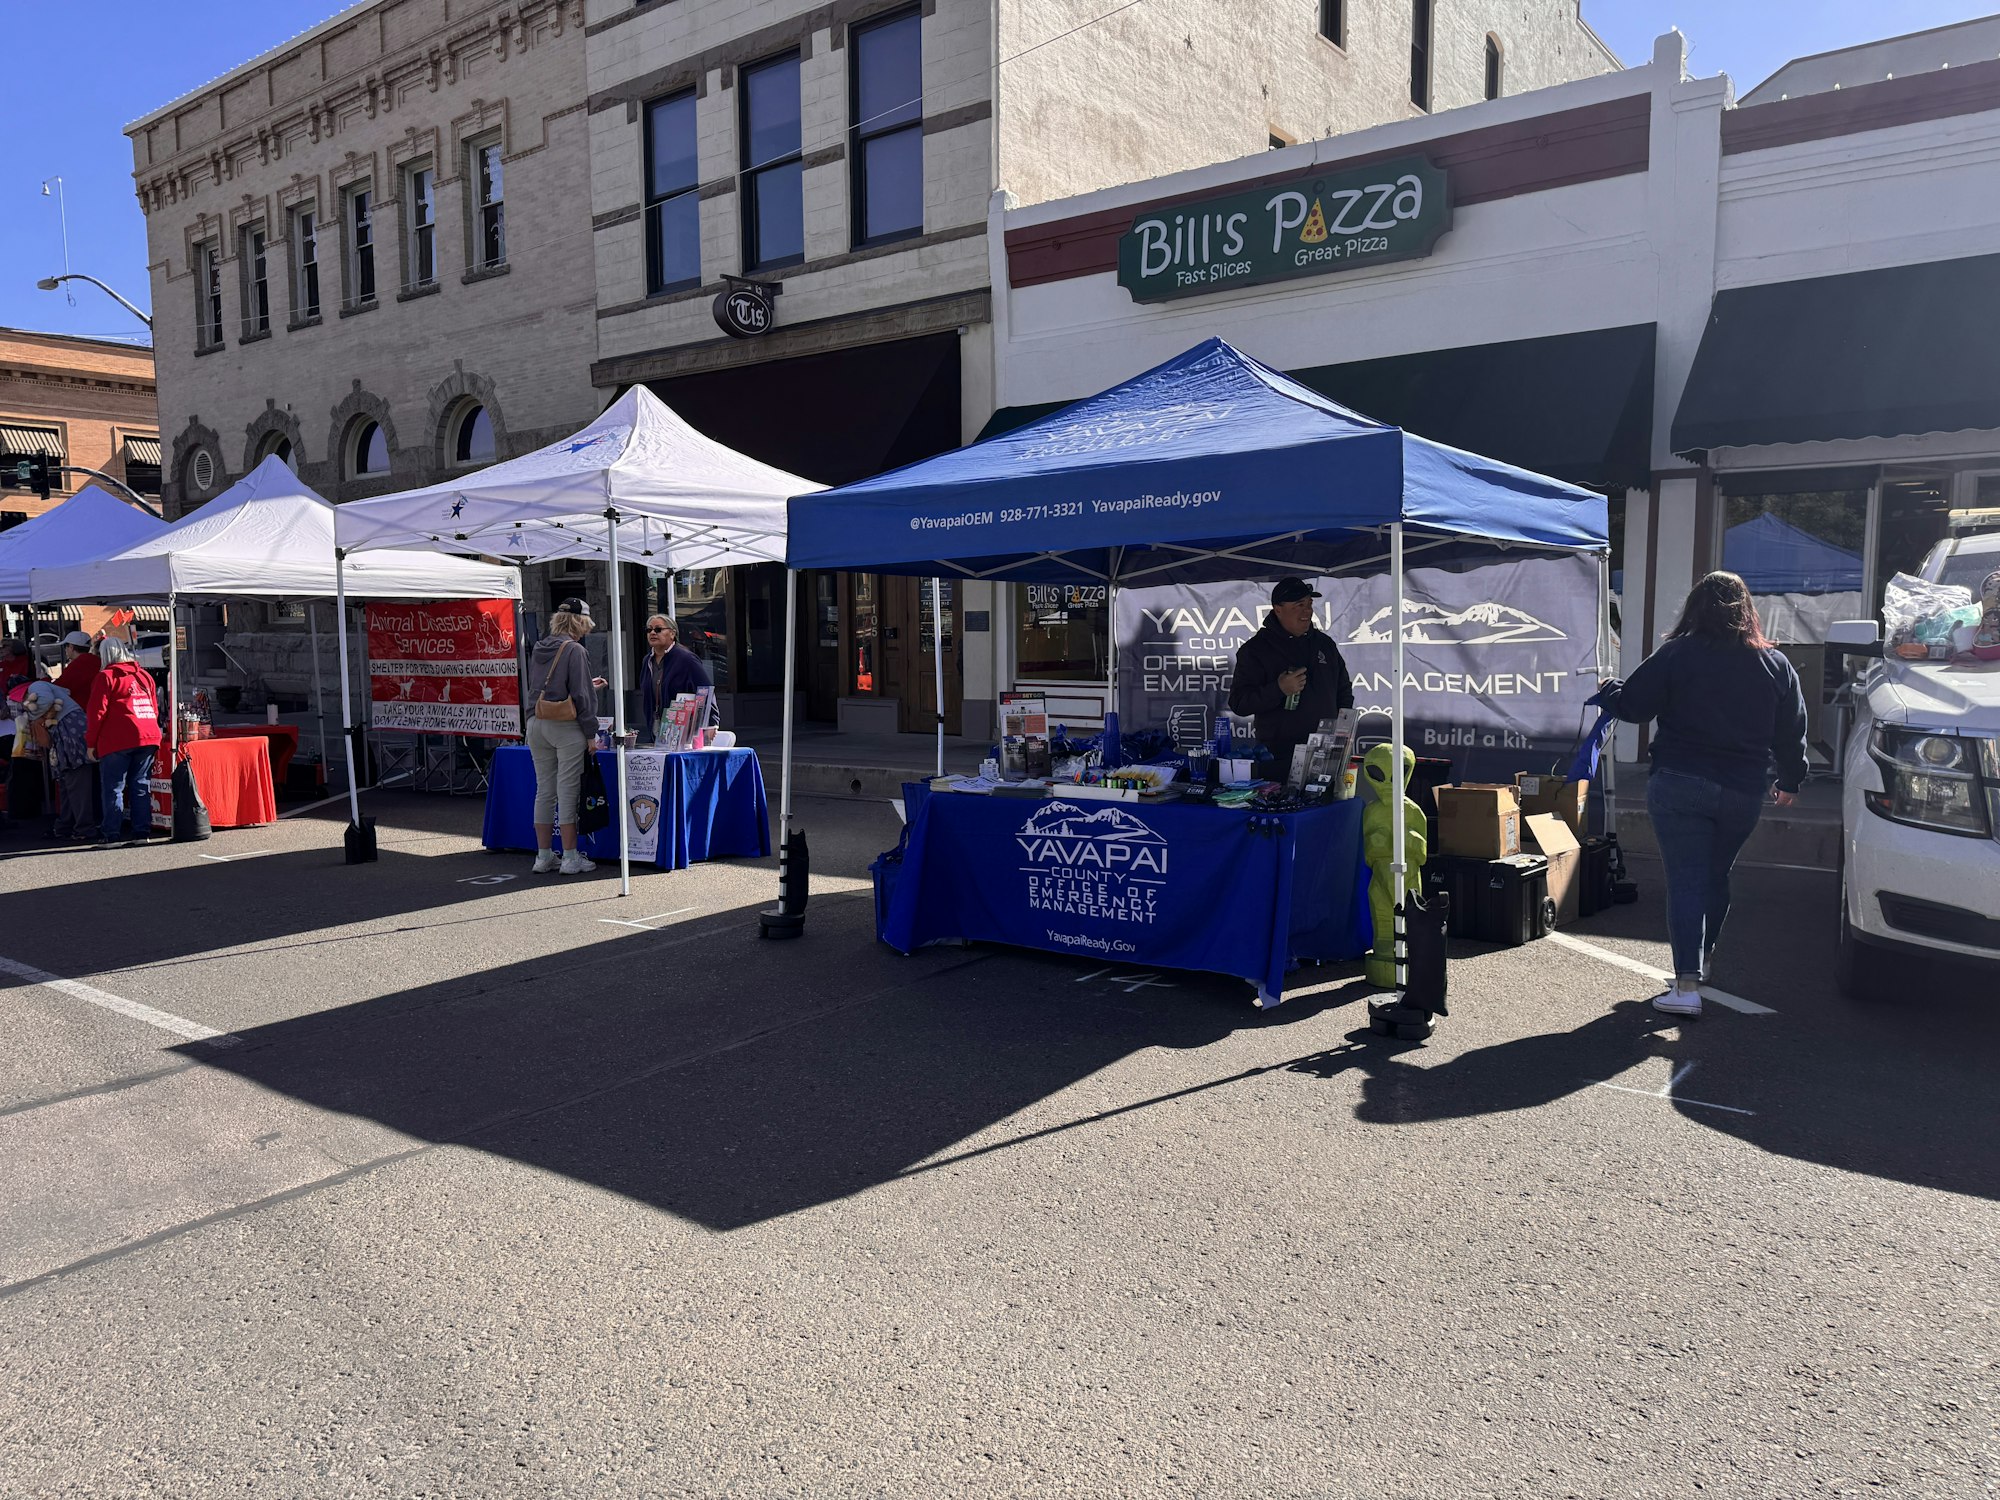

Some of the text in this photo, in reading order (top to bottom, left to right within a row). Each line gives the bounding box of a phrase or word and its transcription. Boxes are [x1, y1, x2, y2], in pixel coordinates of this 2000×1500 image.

[1134, 212, 1248, 279] Bill's
[1294, 235, 1389, 266] Great Pizza
[1175, 260, 1251, 287] Fast Slices
[910, 490, 1222, 531] @YavapaiOEM 928-771-3321 YavapaiReady.gov
[1026, 585, 1060, 604] Bill's
[370, 610, 475, 633] Animal Disaster
[394, 633, 456, 654] Services
[371, 662, 403, 674] SHELTER
[405, 663, 419, 674] FOR
[436, 663, 464, 676] DURING
[465, 662, 516, 674] EVACUATIONS
[1143, 655, 1229, 671] OFFICE
[1351, 671, 1568, 695] ANAGEMENT
[383, 703, 402, 715] TAKE
[404, 704, 425, 716] YOUR
[426, 705, 464, 718] ANIMALS
[465, 706, 488, 719] WITH
[423, 716, 446, 728] HOME
[447, 716, 489, 731] WITHOUT
[490, 720, 518, 733] THEM.
[1424, 728, 1534, 749] Build a kit.
[628, 764, 661, 772] YAVAPAI
[1016, 837, 1168, 874] YAVAPAI
[1051, 866, 1126, 884] COUNTY
[1029, 876, 1157, 900] OFFICE OF
[1029, 886, 1157, 912] EMERGENCY
[1030, 898, 1157, 924] MANAGEMENT
[1046, 929, 1136, 953] YavapaiReady.Gov
